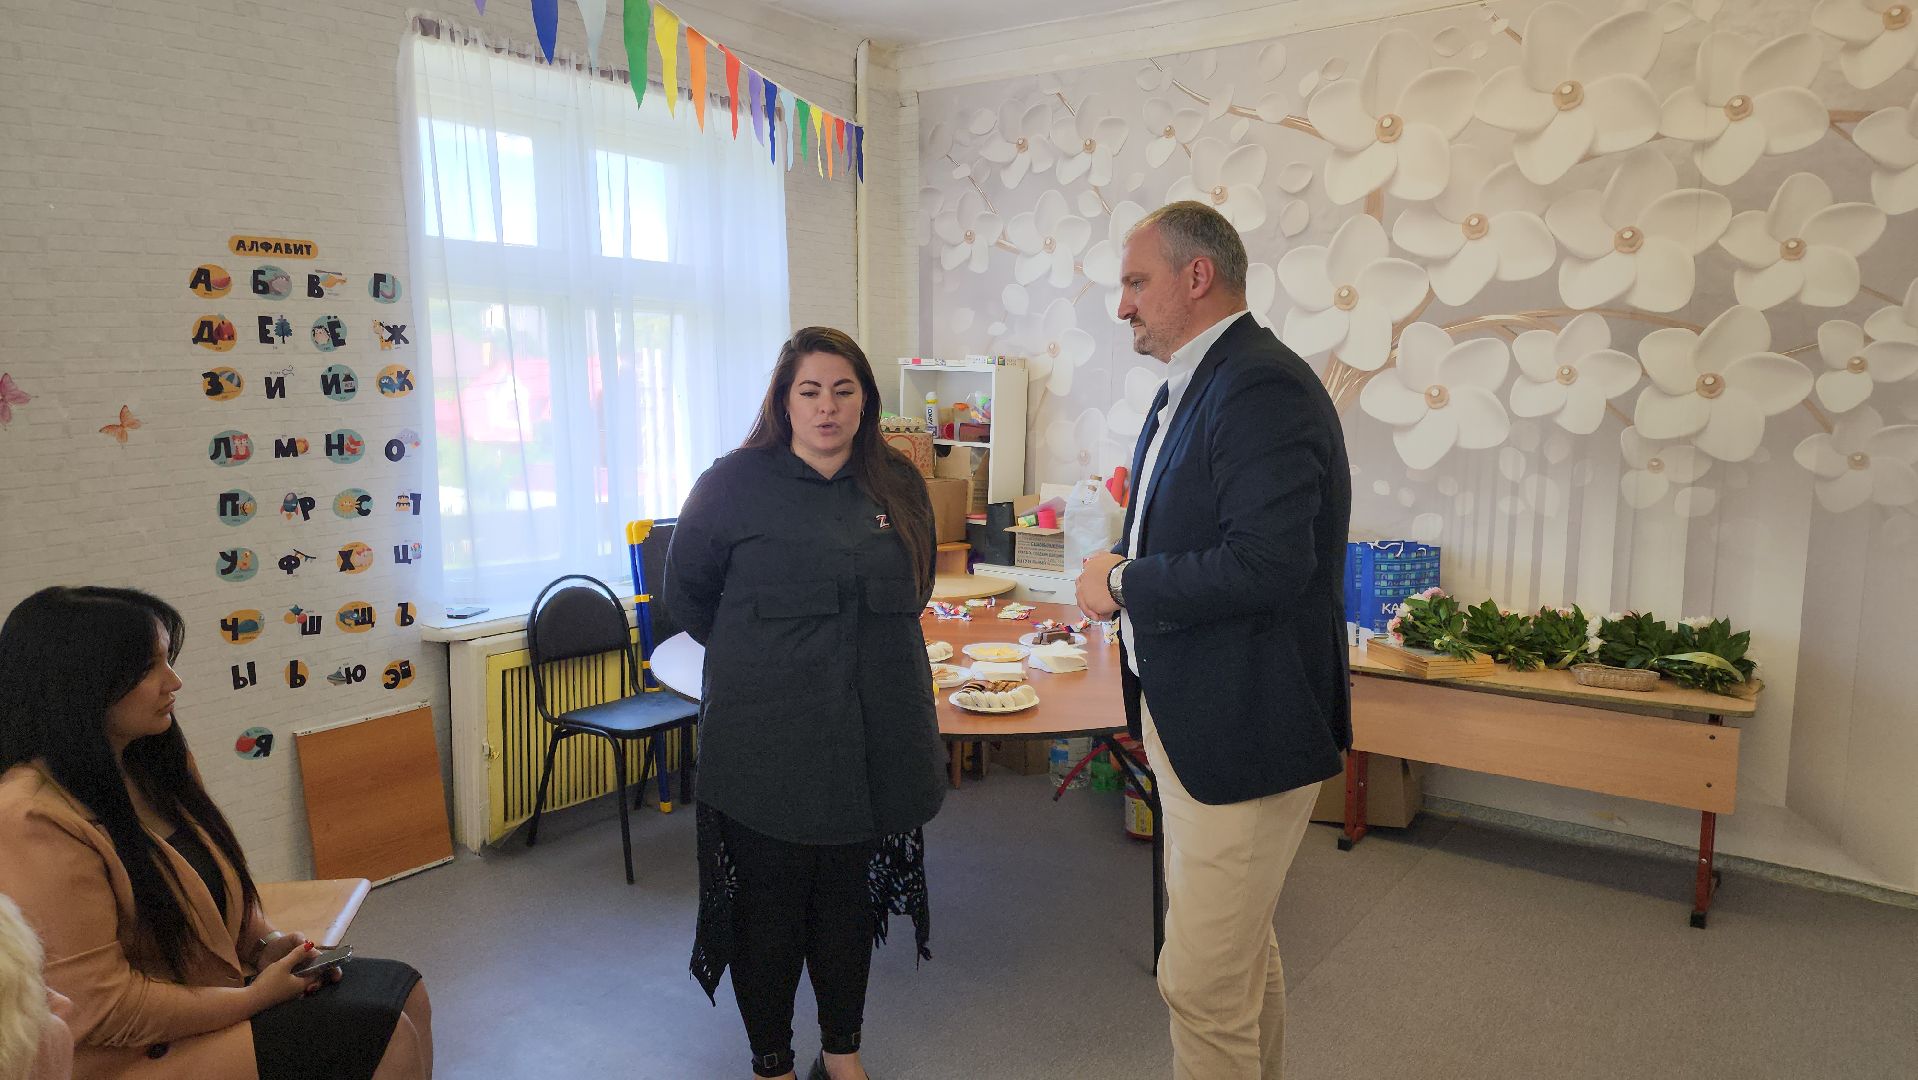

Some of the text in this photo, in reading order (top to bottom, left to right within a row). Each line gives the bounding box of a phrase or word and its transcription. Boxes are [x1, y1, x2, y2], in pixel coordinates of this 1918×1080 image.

[236, 239, 312, 256] АЛФАВИТ
[189, 267, 387, 299] А Б В Г
[192, 315, 410, 348] Д Е Ё Ж
[201, 367, 414, 399] З И Й К
[209, 433, 406, 462] Л М Н О
[219, 492, 422, 521] П Р С Т
[875, 514, 891, 529] Z
[218, 544, 412, 576] У Ф Х Ц
[220, 602, 415, 641] Ч Ш Щ Ъ
[231, 659, 401, 690] Ы Ь Ю Э
[253, 734, 274, 758] Я
